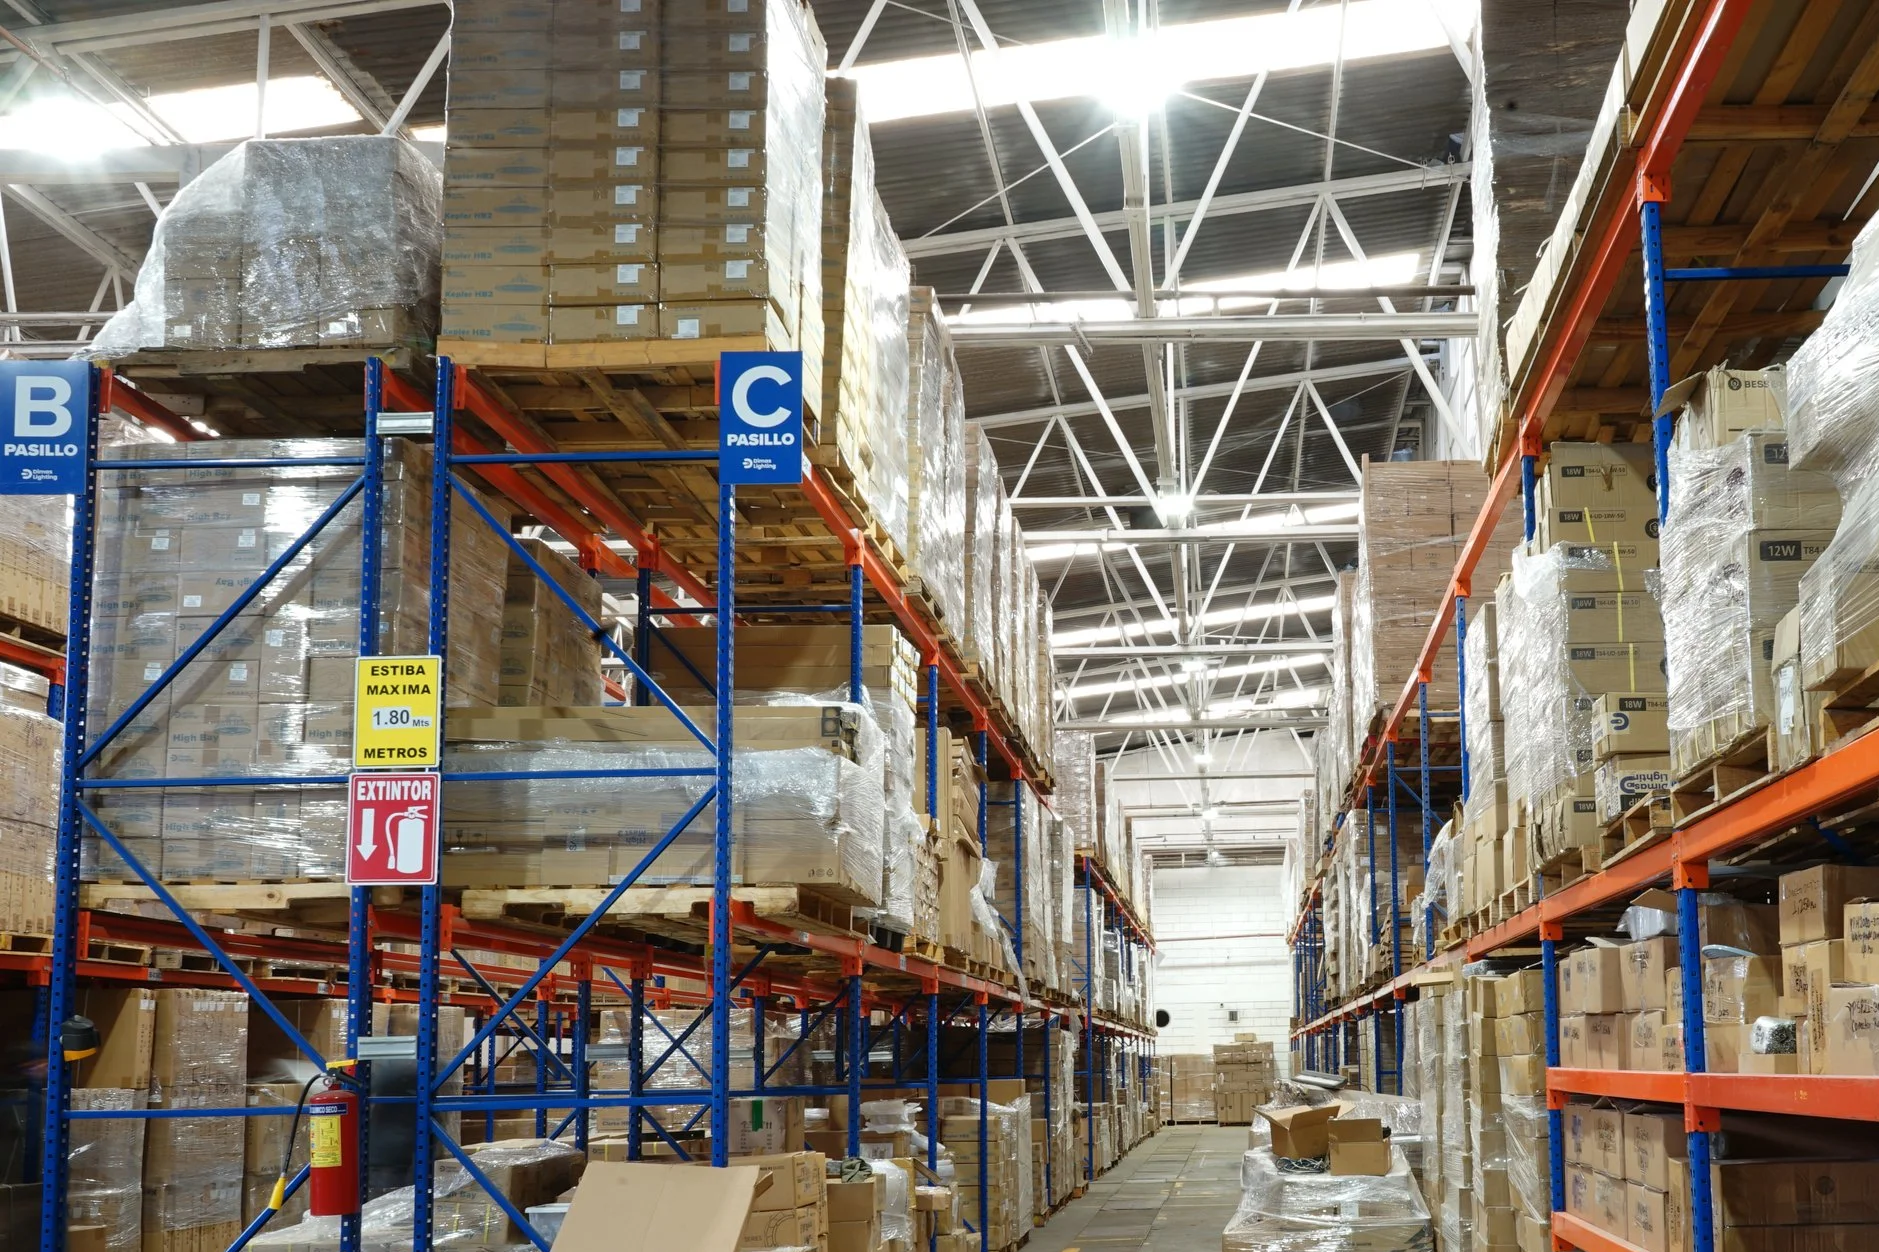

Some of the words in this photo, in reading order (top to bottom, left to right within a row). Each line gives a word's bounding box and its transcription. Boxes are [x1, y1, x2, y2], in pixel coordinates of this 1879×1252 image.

[731, 365, 792, 428] C
[14, 375, 72, 437] B
[726, 432, 795, 447] PASILLO
[4, 443, 78, 457] PASILLO
[753, 463, 776, 471] Lighting
[33, 474, 58, 482] Lighting
[1768, 545, 1796, 556] 12W
[96, 601, 119, 610] High
[370, 665, 425, 676] ESTIBA
[366, 684, 431, 696] MAXIMA
[1625, 700, 1643, 708] 18W
[373, 709, 410, 727] 1.80
[412, 718, 430, 727] Mts
[173, 733, 196, 743] High
[200, 733, 219, 743] Bay
[308, 729, 332, 739] High
[364, 747, 427, 759] METROS
[357, 780, 432, 801] EXTINTOR
